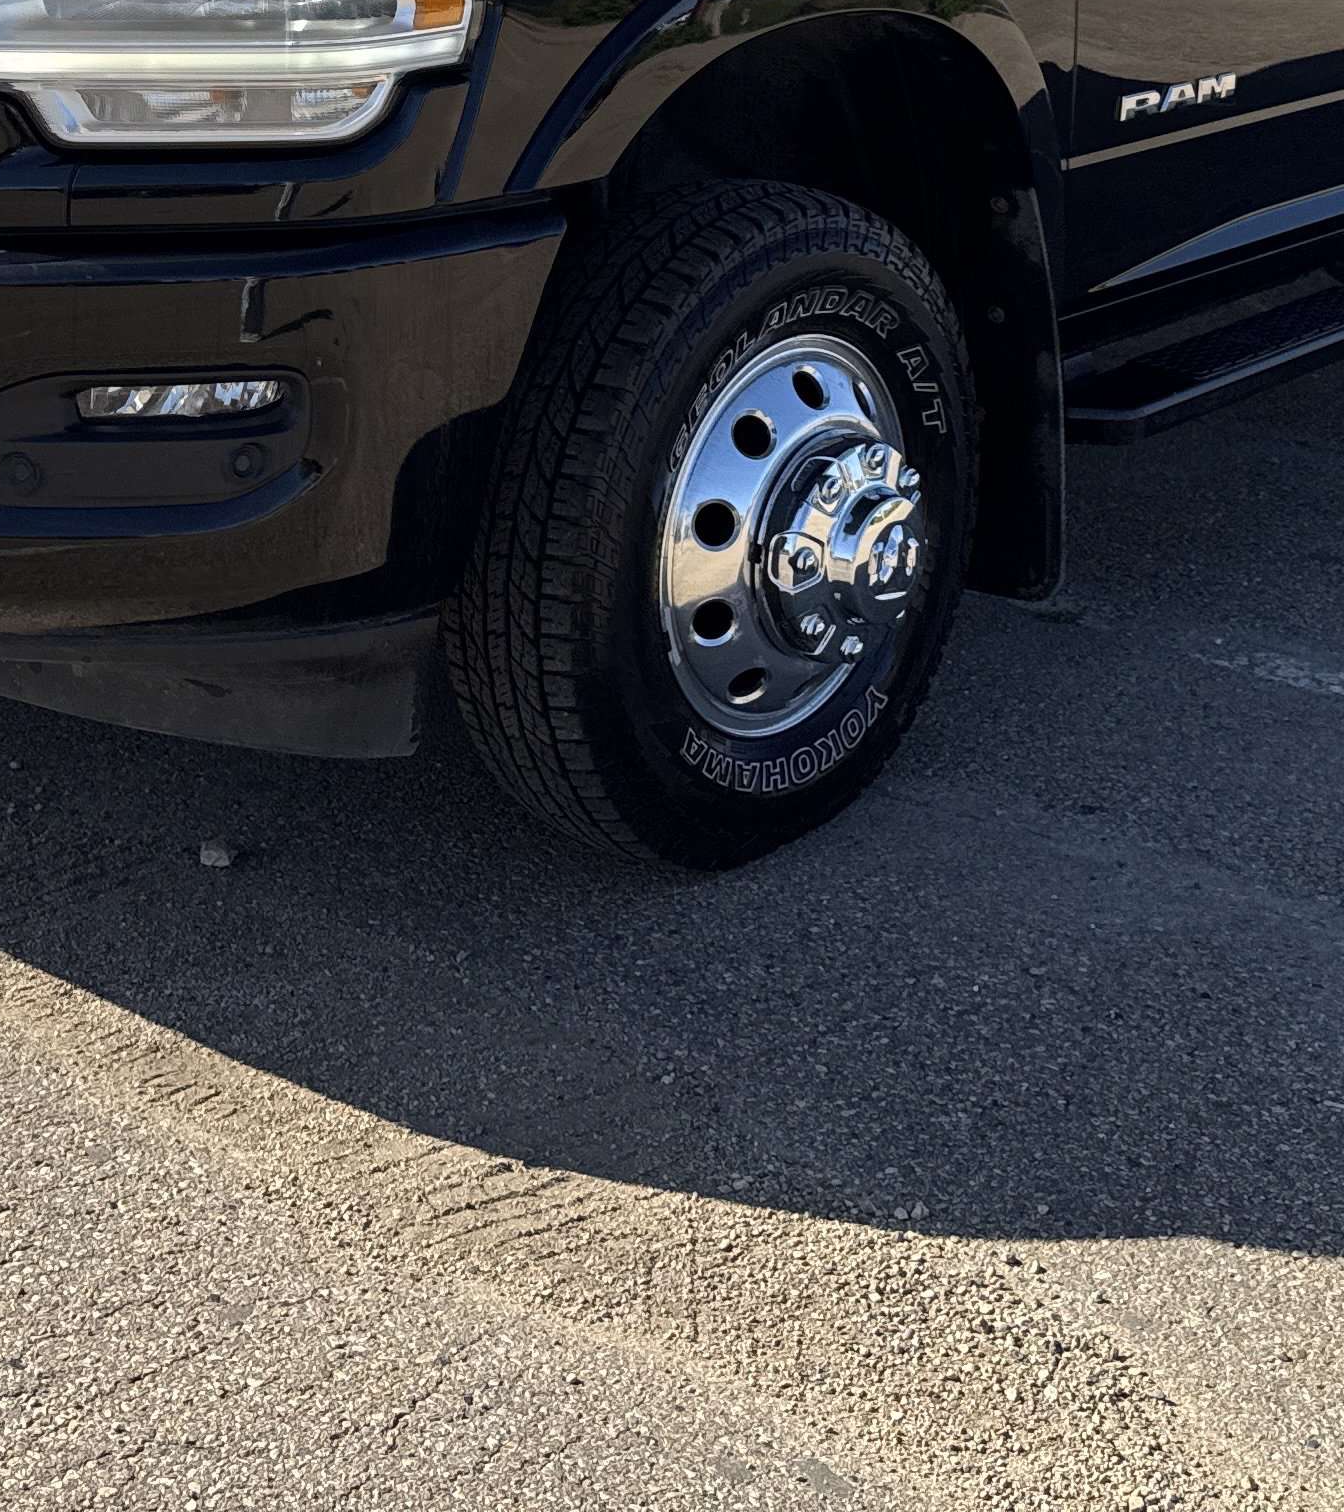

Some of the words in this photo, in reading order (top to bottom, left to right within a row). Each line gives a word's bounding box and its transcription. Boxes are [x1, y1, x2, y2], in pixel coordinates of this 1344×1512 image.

[1119, 71, 1236, 122] RAM
[669, 285, 900, 473] GEOLANDAR
[896, 343, 948, 435] A/T
[679, 685, 889, 793] YOKOHAMA
